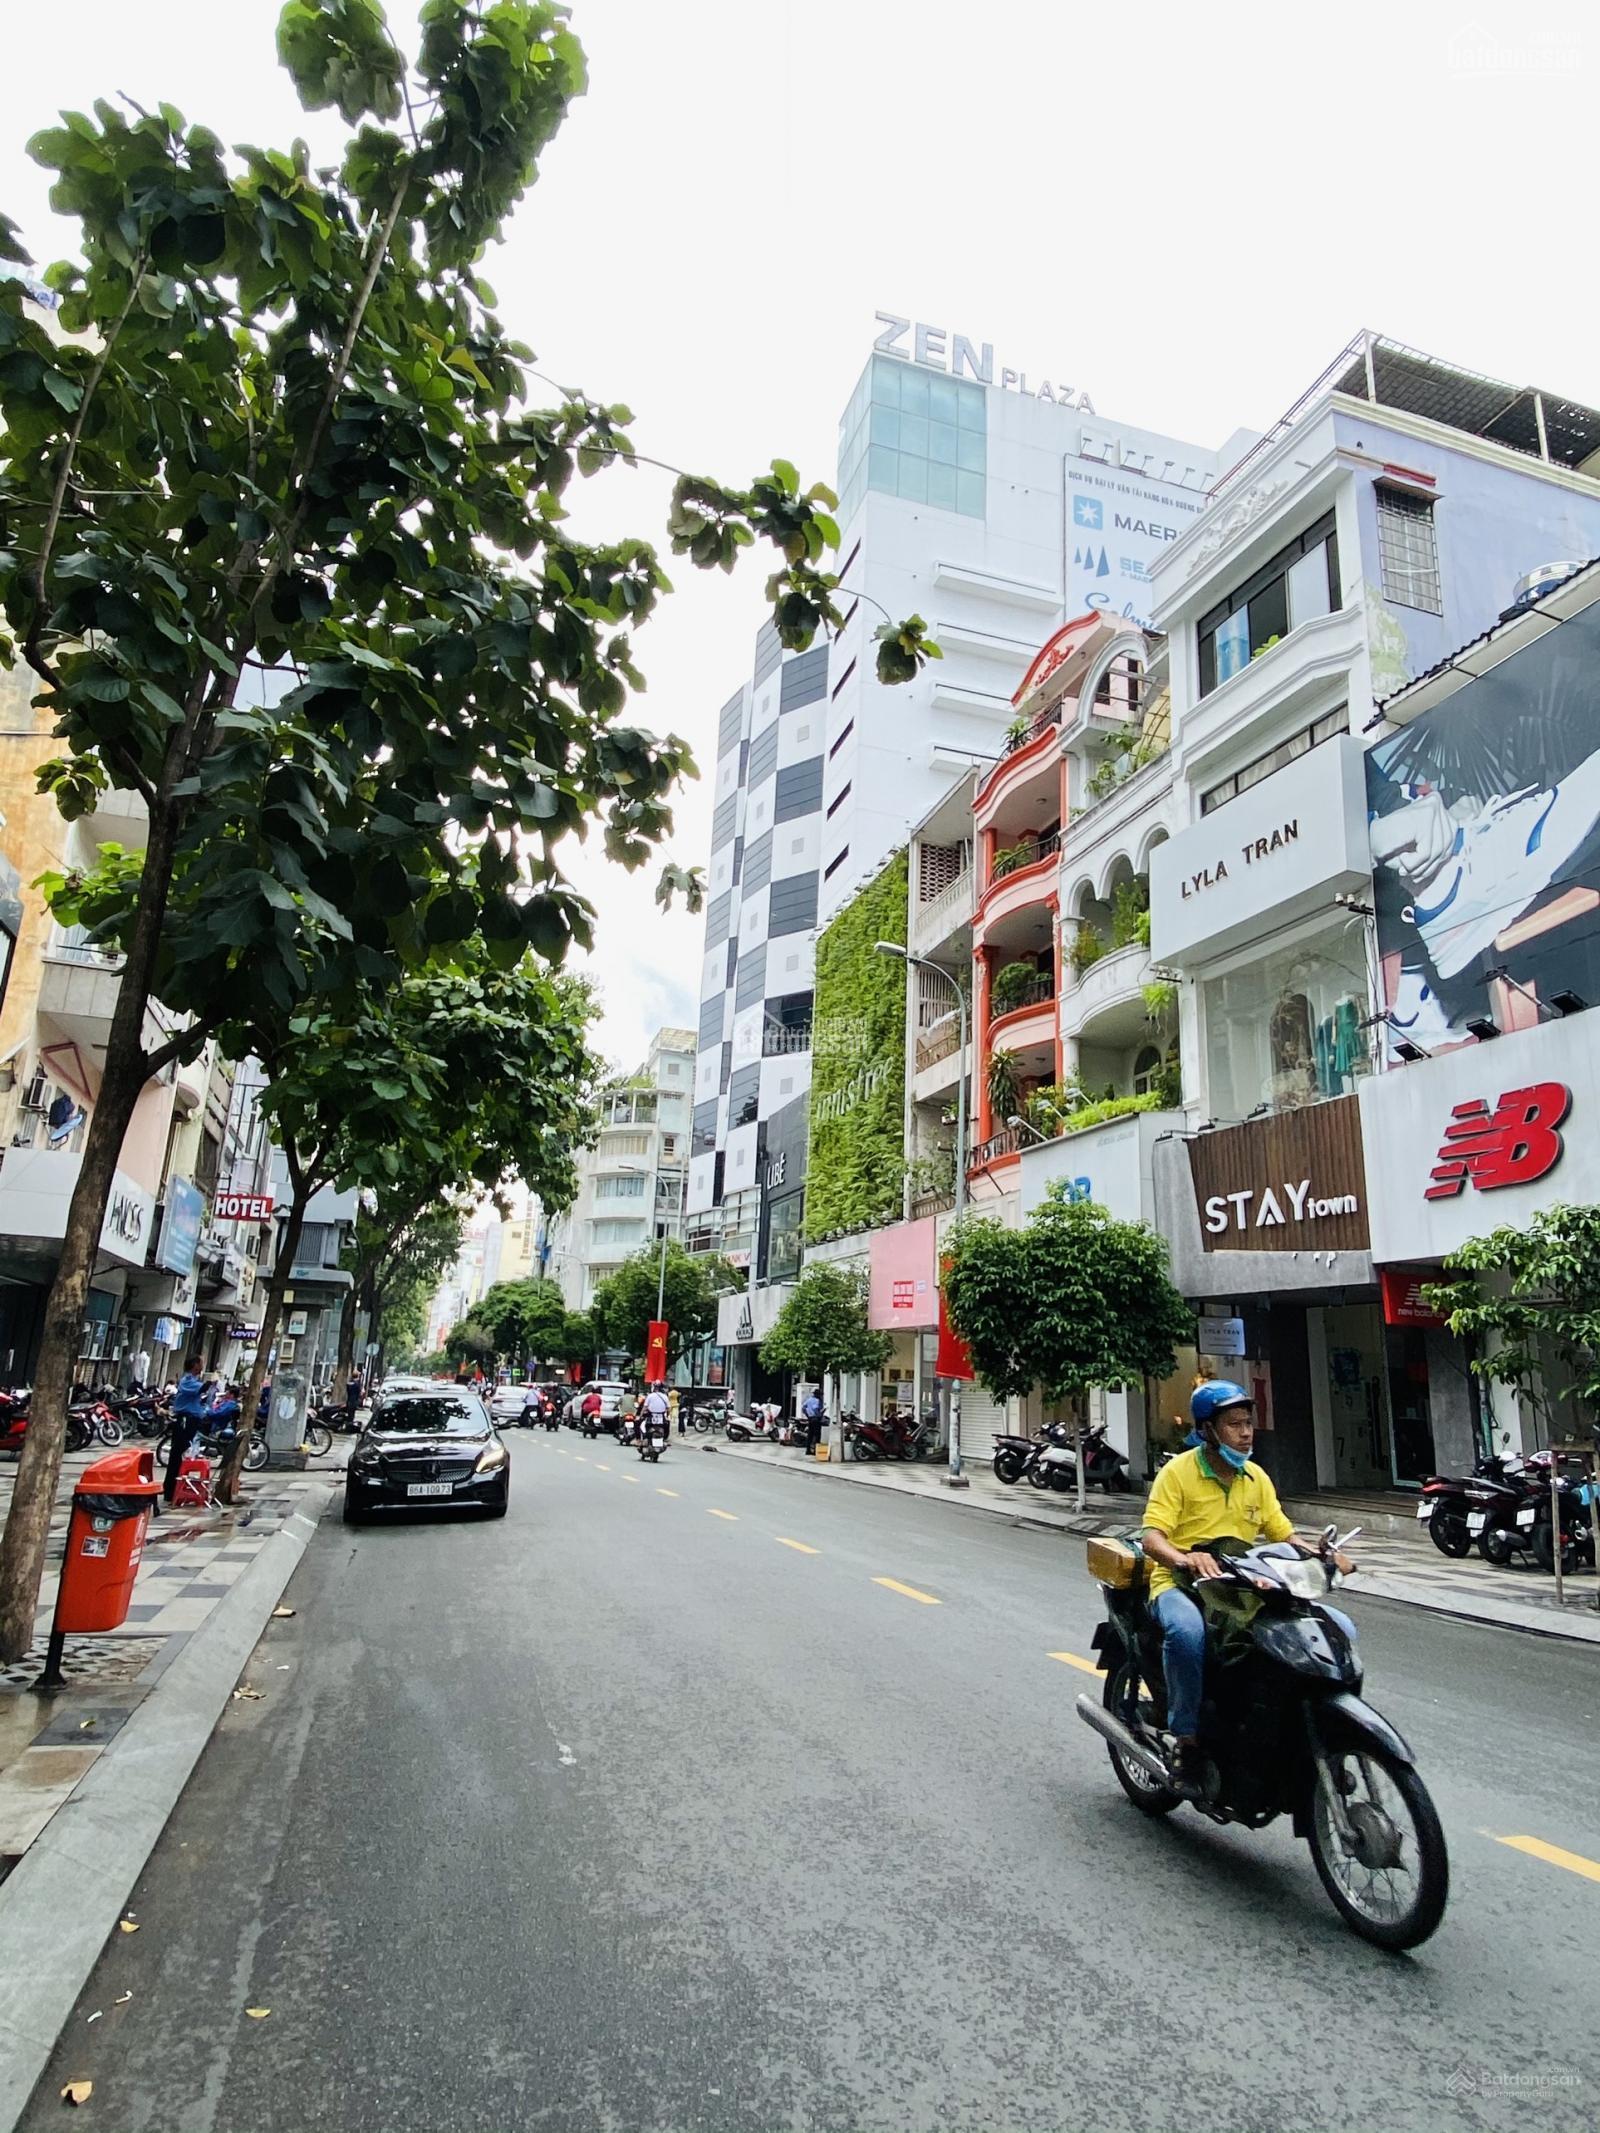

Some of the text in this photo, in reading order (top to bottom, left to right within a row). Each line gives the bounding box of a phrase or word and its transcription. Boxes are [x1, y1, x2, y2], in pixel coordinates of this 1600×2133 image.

[873, 311, 1096, 416] ZEN PLAZA
[1114, 513, 1178, 541] MAER
[1181, 819, 1299, 899] LYLA TRAN
[767, 1152, 786, 1190] LIBÉ
[215, 1198, 271, 1218] HOTEL
